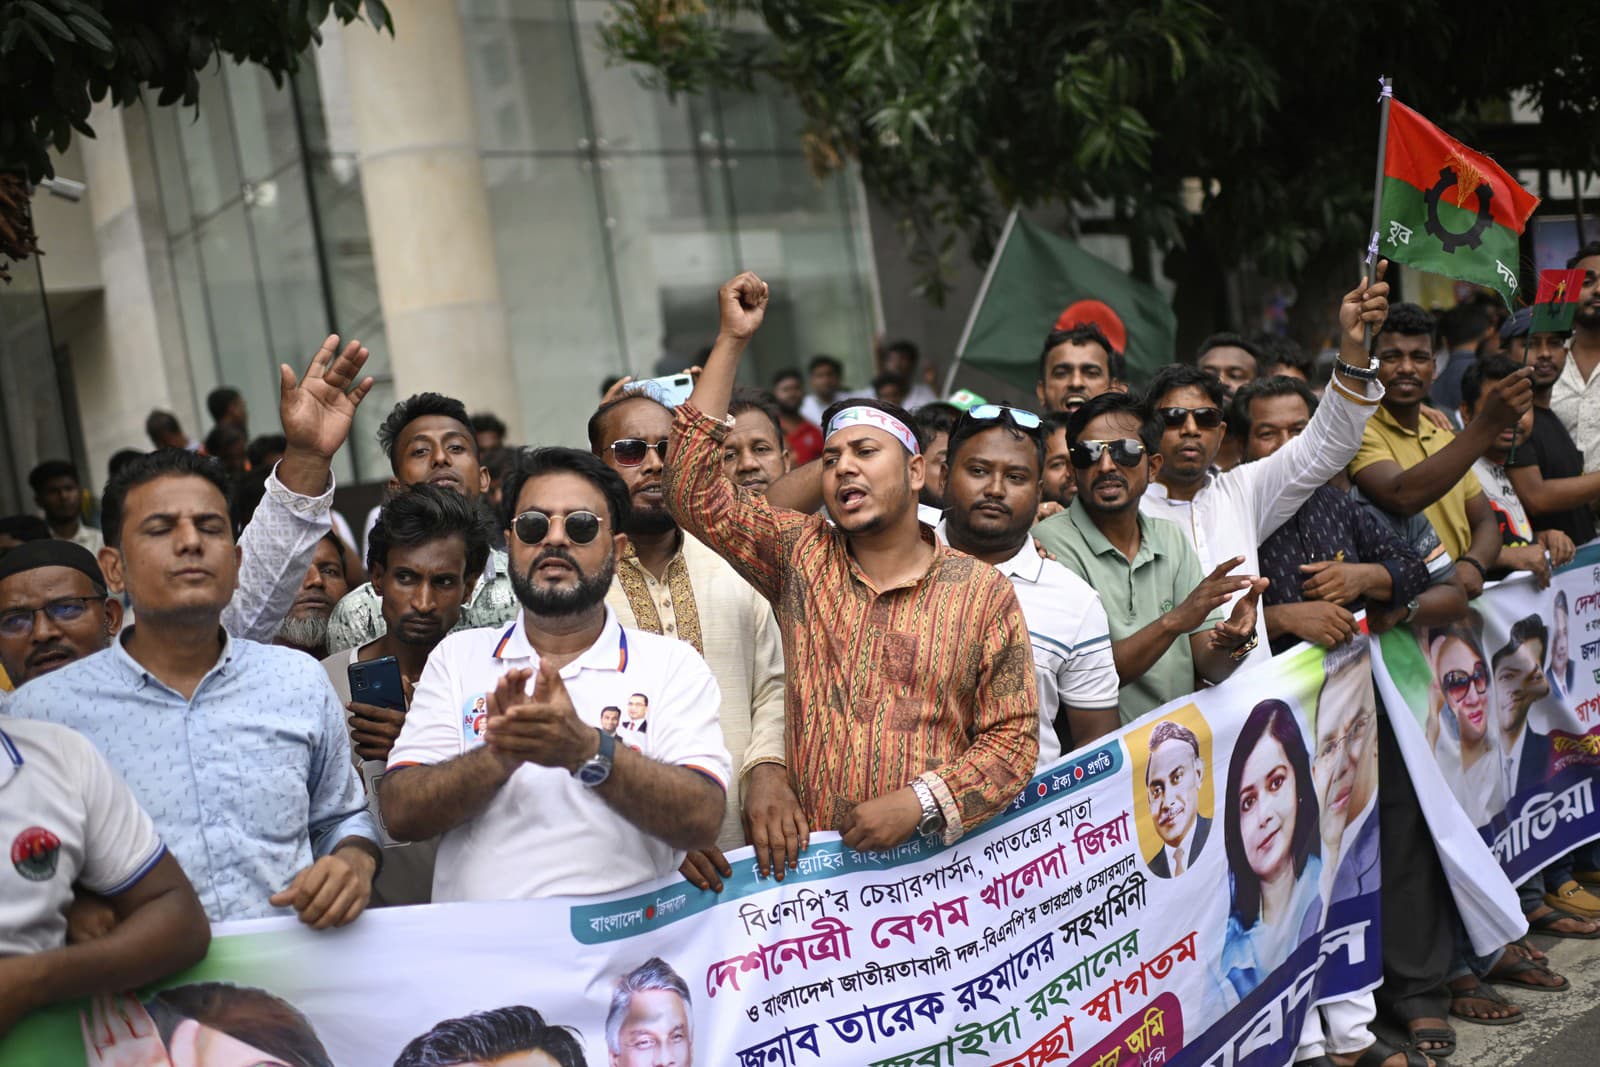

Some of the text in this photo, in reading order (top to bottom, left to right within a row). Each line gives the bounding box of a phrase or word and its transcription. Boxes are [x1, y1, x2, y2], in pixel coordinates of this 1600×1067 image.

[1052, 773, 1071, 791] ঐক্য
[1087, 752, 1110, 775] প্রগতি
[861, 852, 983, 907] চেয়ারপার্সন,
[984, 817, 1052, 864] গণতন্ত্রের
[1057, 797, 1092, 829] মাতা
[1487, 777, 1594, 866] লাতিয়া
[590, 908, 643, 932] বাংলাদেশ
[707, 810, 1130, 998] দেশনেত্রী বেগম খালেদা জিয়া
[746, 1005, 760, 1022] ও
[762, 978, 834, 1018] বাংলাদেশ
[838, 946, 951, 992] জাতীয়তাবাদী
[1040, 881, 1083, 916] ভারপ্রাপ্ত
[1086, 853, 1136, 893] চেয়ারম্যান
[736, 1024, 821, 1067] জনাব
[826, 991, 945, 1043] তারেক
[952, 932, 1055, 1012] রহমানের
[1025, 929, 1140, 1021] রহমানের
[1080, 931, 1198, 1022] স্বাগতম
